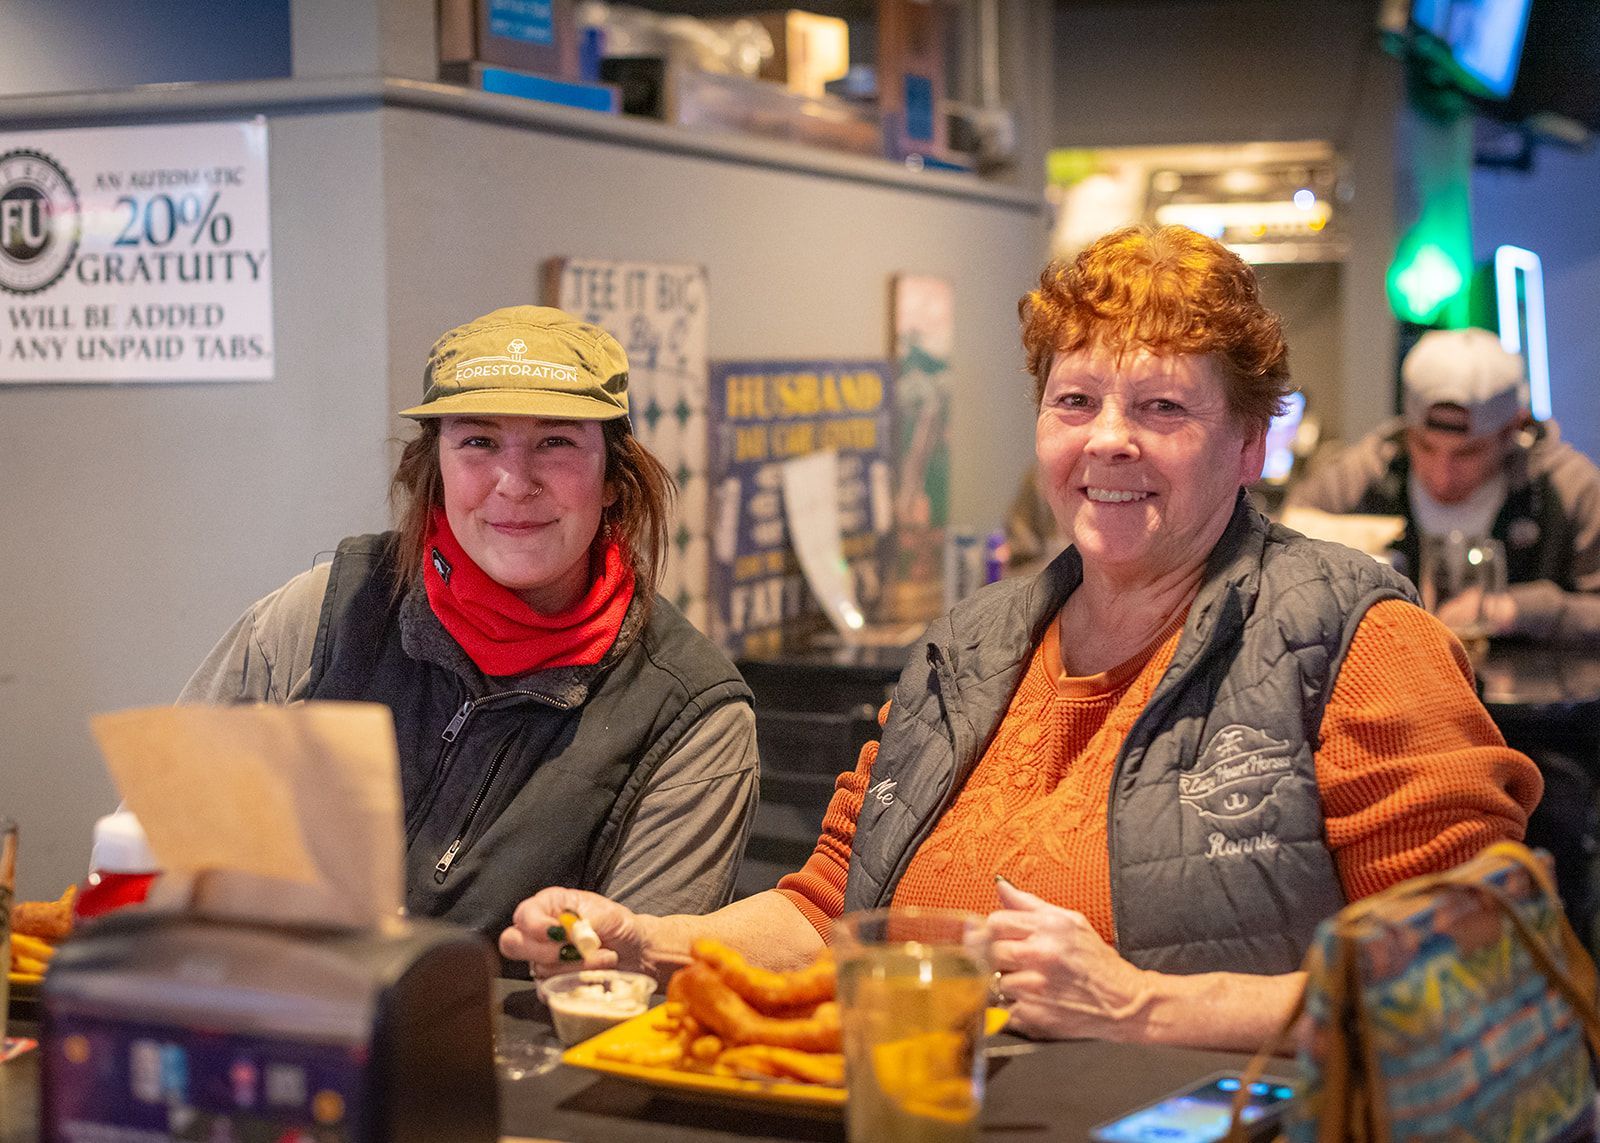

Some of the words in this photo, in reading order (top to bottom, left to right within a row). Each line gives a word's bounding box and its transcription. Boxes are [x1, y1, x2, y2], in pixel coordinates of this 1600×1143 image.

[96, 173, 122, 190] AN
[130, 166, 244, 188] AUTOMATIC
[2, 198, 49, 250] FU
[113, 191, 232, 249] 20%
[76, 250, 265, 285] GRATUITY
[8, 305, 75, 330] WILL
[84, 304, 112, 329] BE
[126, 302, 225, 330] ADDED
[9, 335, 69, 361] ANY
[77, 334, 184, 361] UNPAID
[455, 364, 578, 383] FORESTORATION
